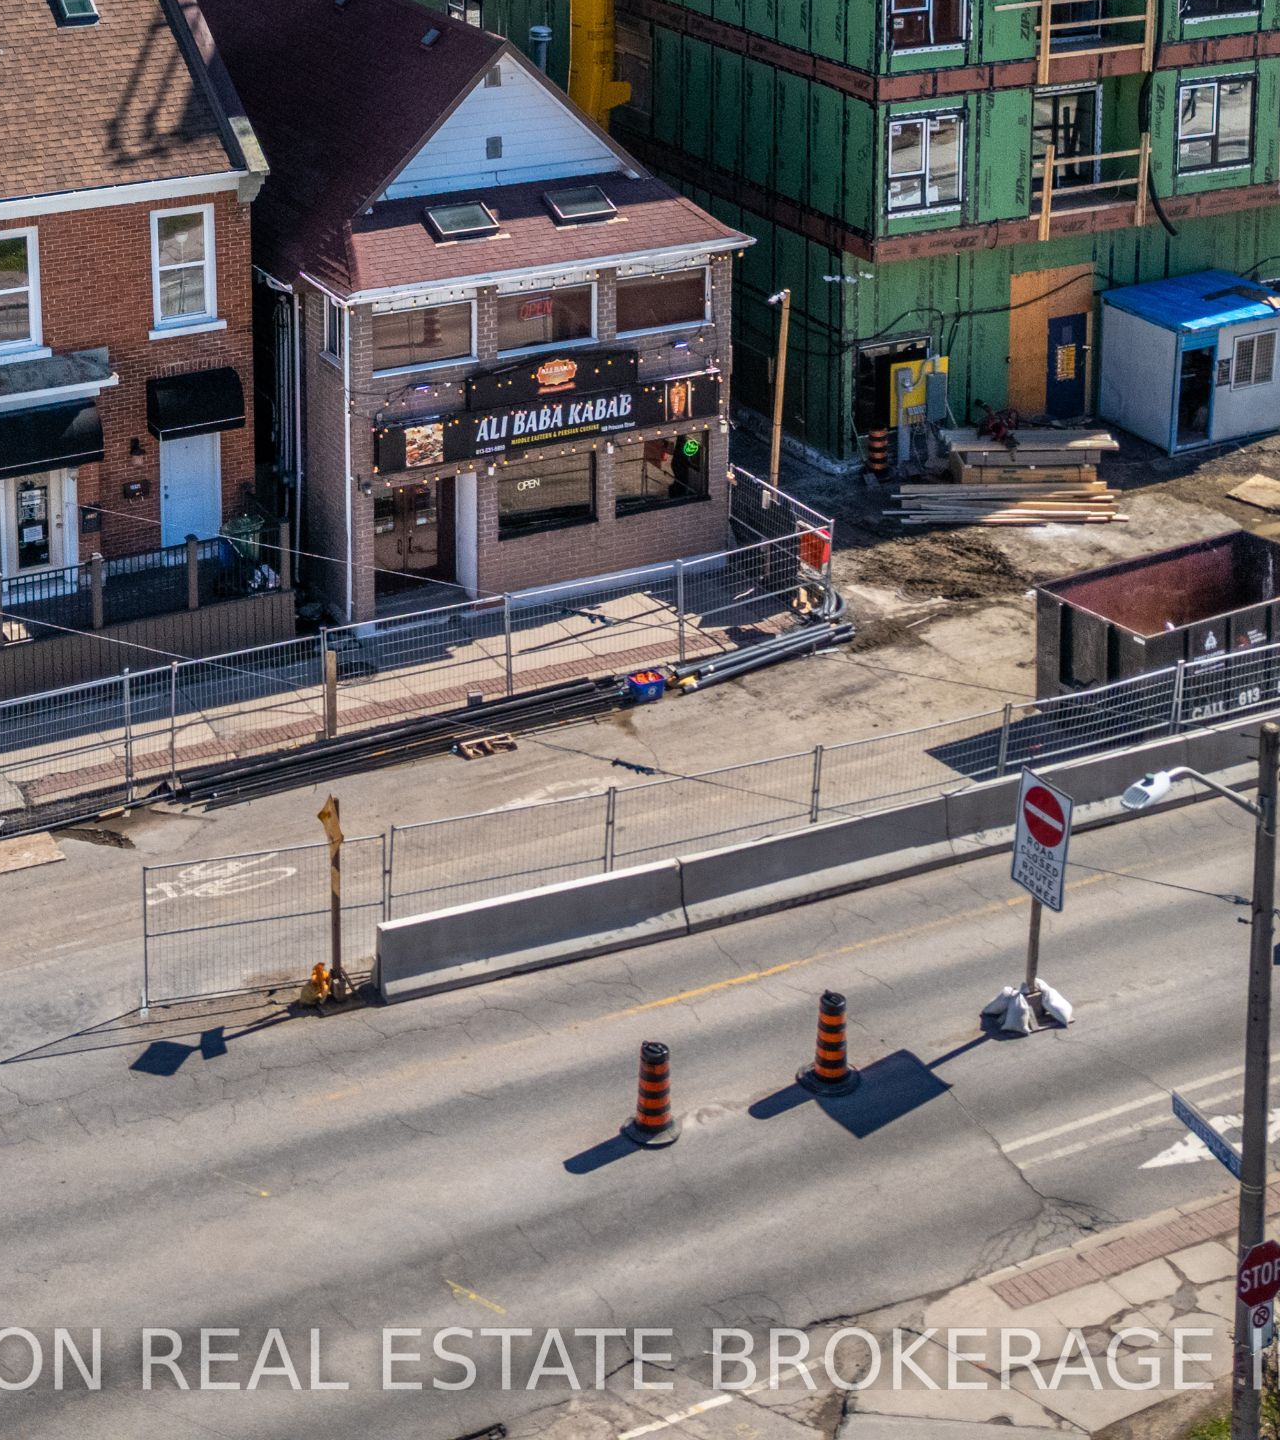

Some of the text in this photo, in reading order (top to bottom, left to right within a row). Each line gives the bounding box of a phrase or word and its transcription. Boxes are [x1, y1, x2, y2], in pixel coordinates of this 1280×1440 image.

[476, 394, 632, 442] ALI BABA KABAB
[517, 477, 540, 491] OPEN
[1021, 844, 1058, 877] CLOSED
[1026, 836, 1054, 860] ROAD
[1022, 860, 1054, 891] ROUTE
